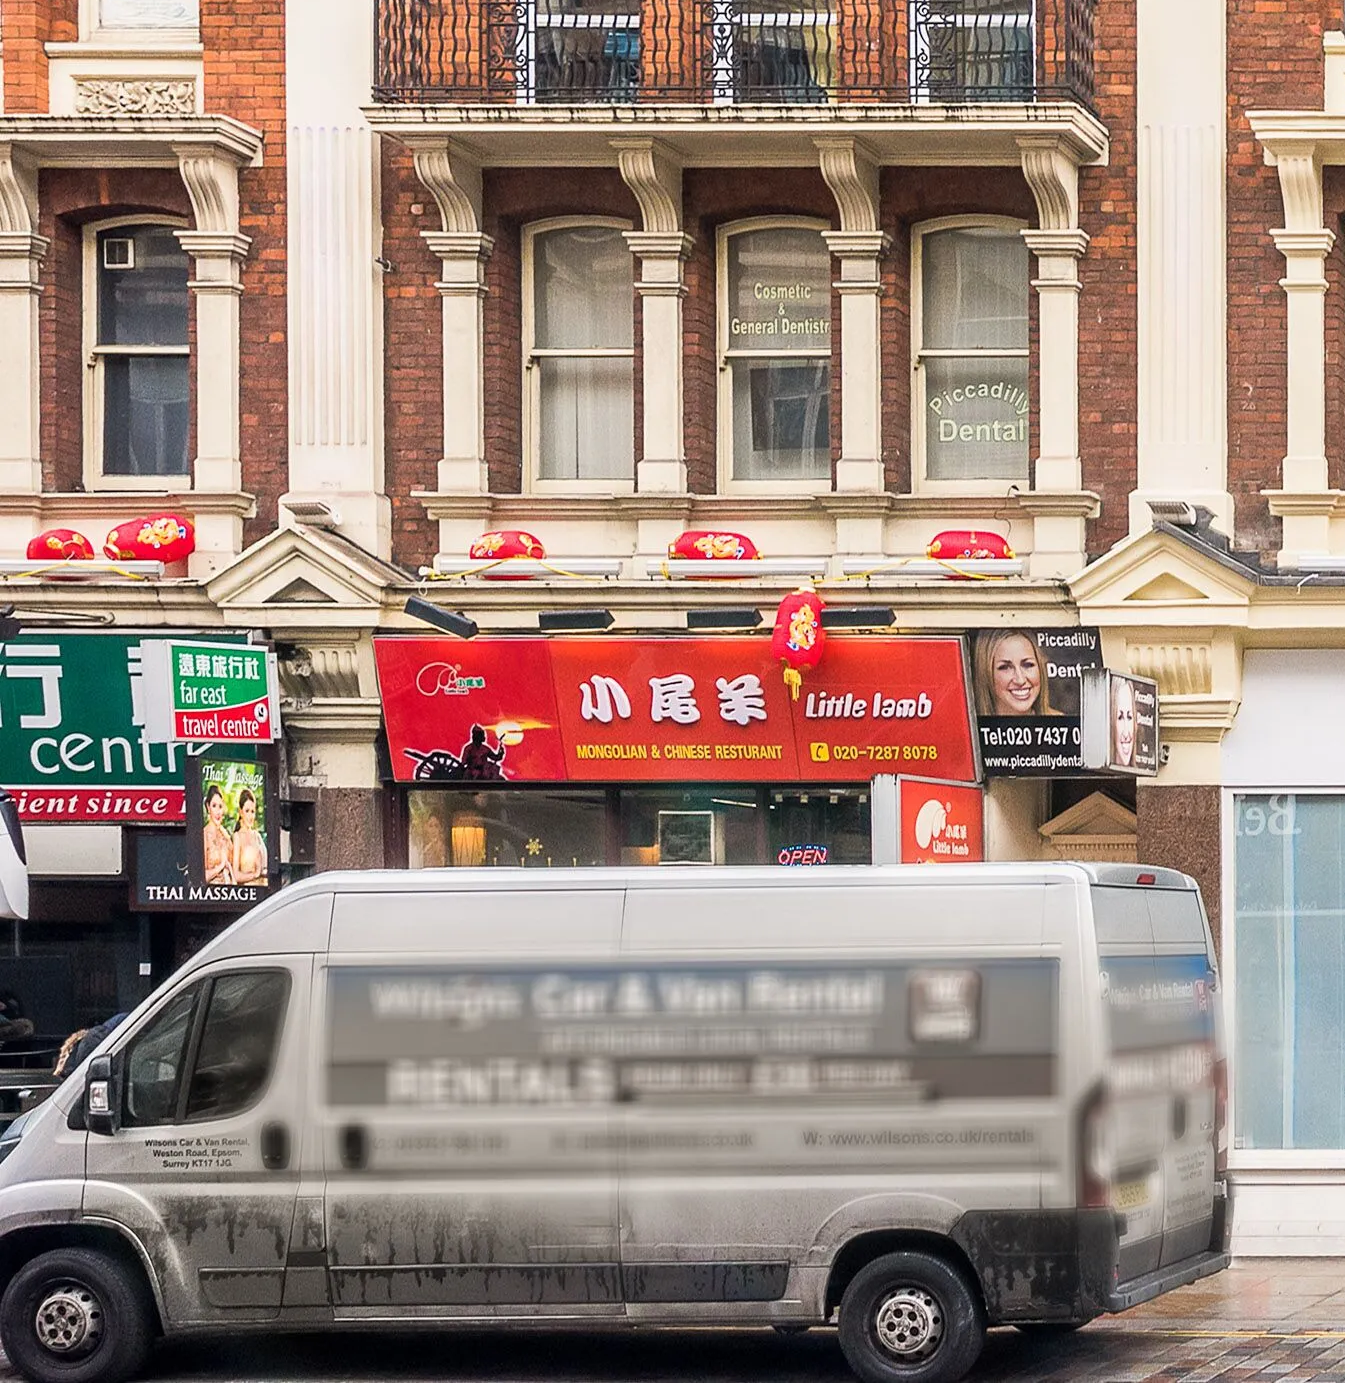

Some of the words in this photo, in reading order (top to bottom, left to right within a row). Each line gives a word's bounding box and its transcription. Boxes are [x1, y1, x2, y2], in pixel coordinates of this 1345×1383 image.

[754, 282, 811, 300] Cosmetic
[778, 302, 785, 316] &
[731, 319, 778, 335] General
[929, 381, 1030, 416] Piccadilly
[939, 420, 1025, 442] Dental
[1037, 633, 1096, 649] Piccadilly
[178, 651, 260, 680] 遠東旅行社
[180, 680, 200, 704] far
[201, 687, 227, 705] east
[580, 673, 768, 726] 小尾羊
[806, 691, 866, 719] Little
[872, 692, 932, 719] lamb
[183, 714, 218, 736] travel
[221, 716, 259, 737] centre
[1035, 728, 1068, 745] 7437
[576, 744, 647, 760] MONGOLIAN
[651, 745, 660, 759] &
[664, 745, 711, 760] CHINESE
[715, 745, 783, 760] RESTURANT
[86, 791, 168, 814] since
[778, 849, 828, 865] OPEN
[146, 886, 183, 900] THAI
[189, 887, 257, 901] MASSAGE
[145, 1139, 177, 1147] Wilsons
[179, 1138, 193, 1146] Car
[204, 1138, 219, 1146] Van
[803, 1130, 824, 1145] W:
[828, 1129, 1034, 1146] www.wilsons.co.uk/rentals
[153, 1149, 183, 1157] Weston
[185, 1149, 209, 1158] Road,
[162, 1159, 189, 1169] Surrey
[192, 1159, 213, 1167] KT17
